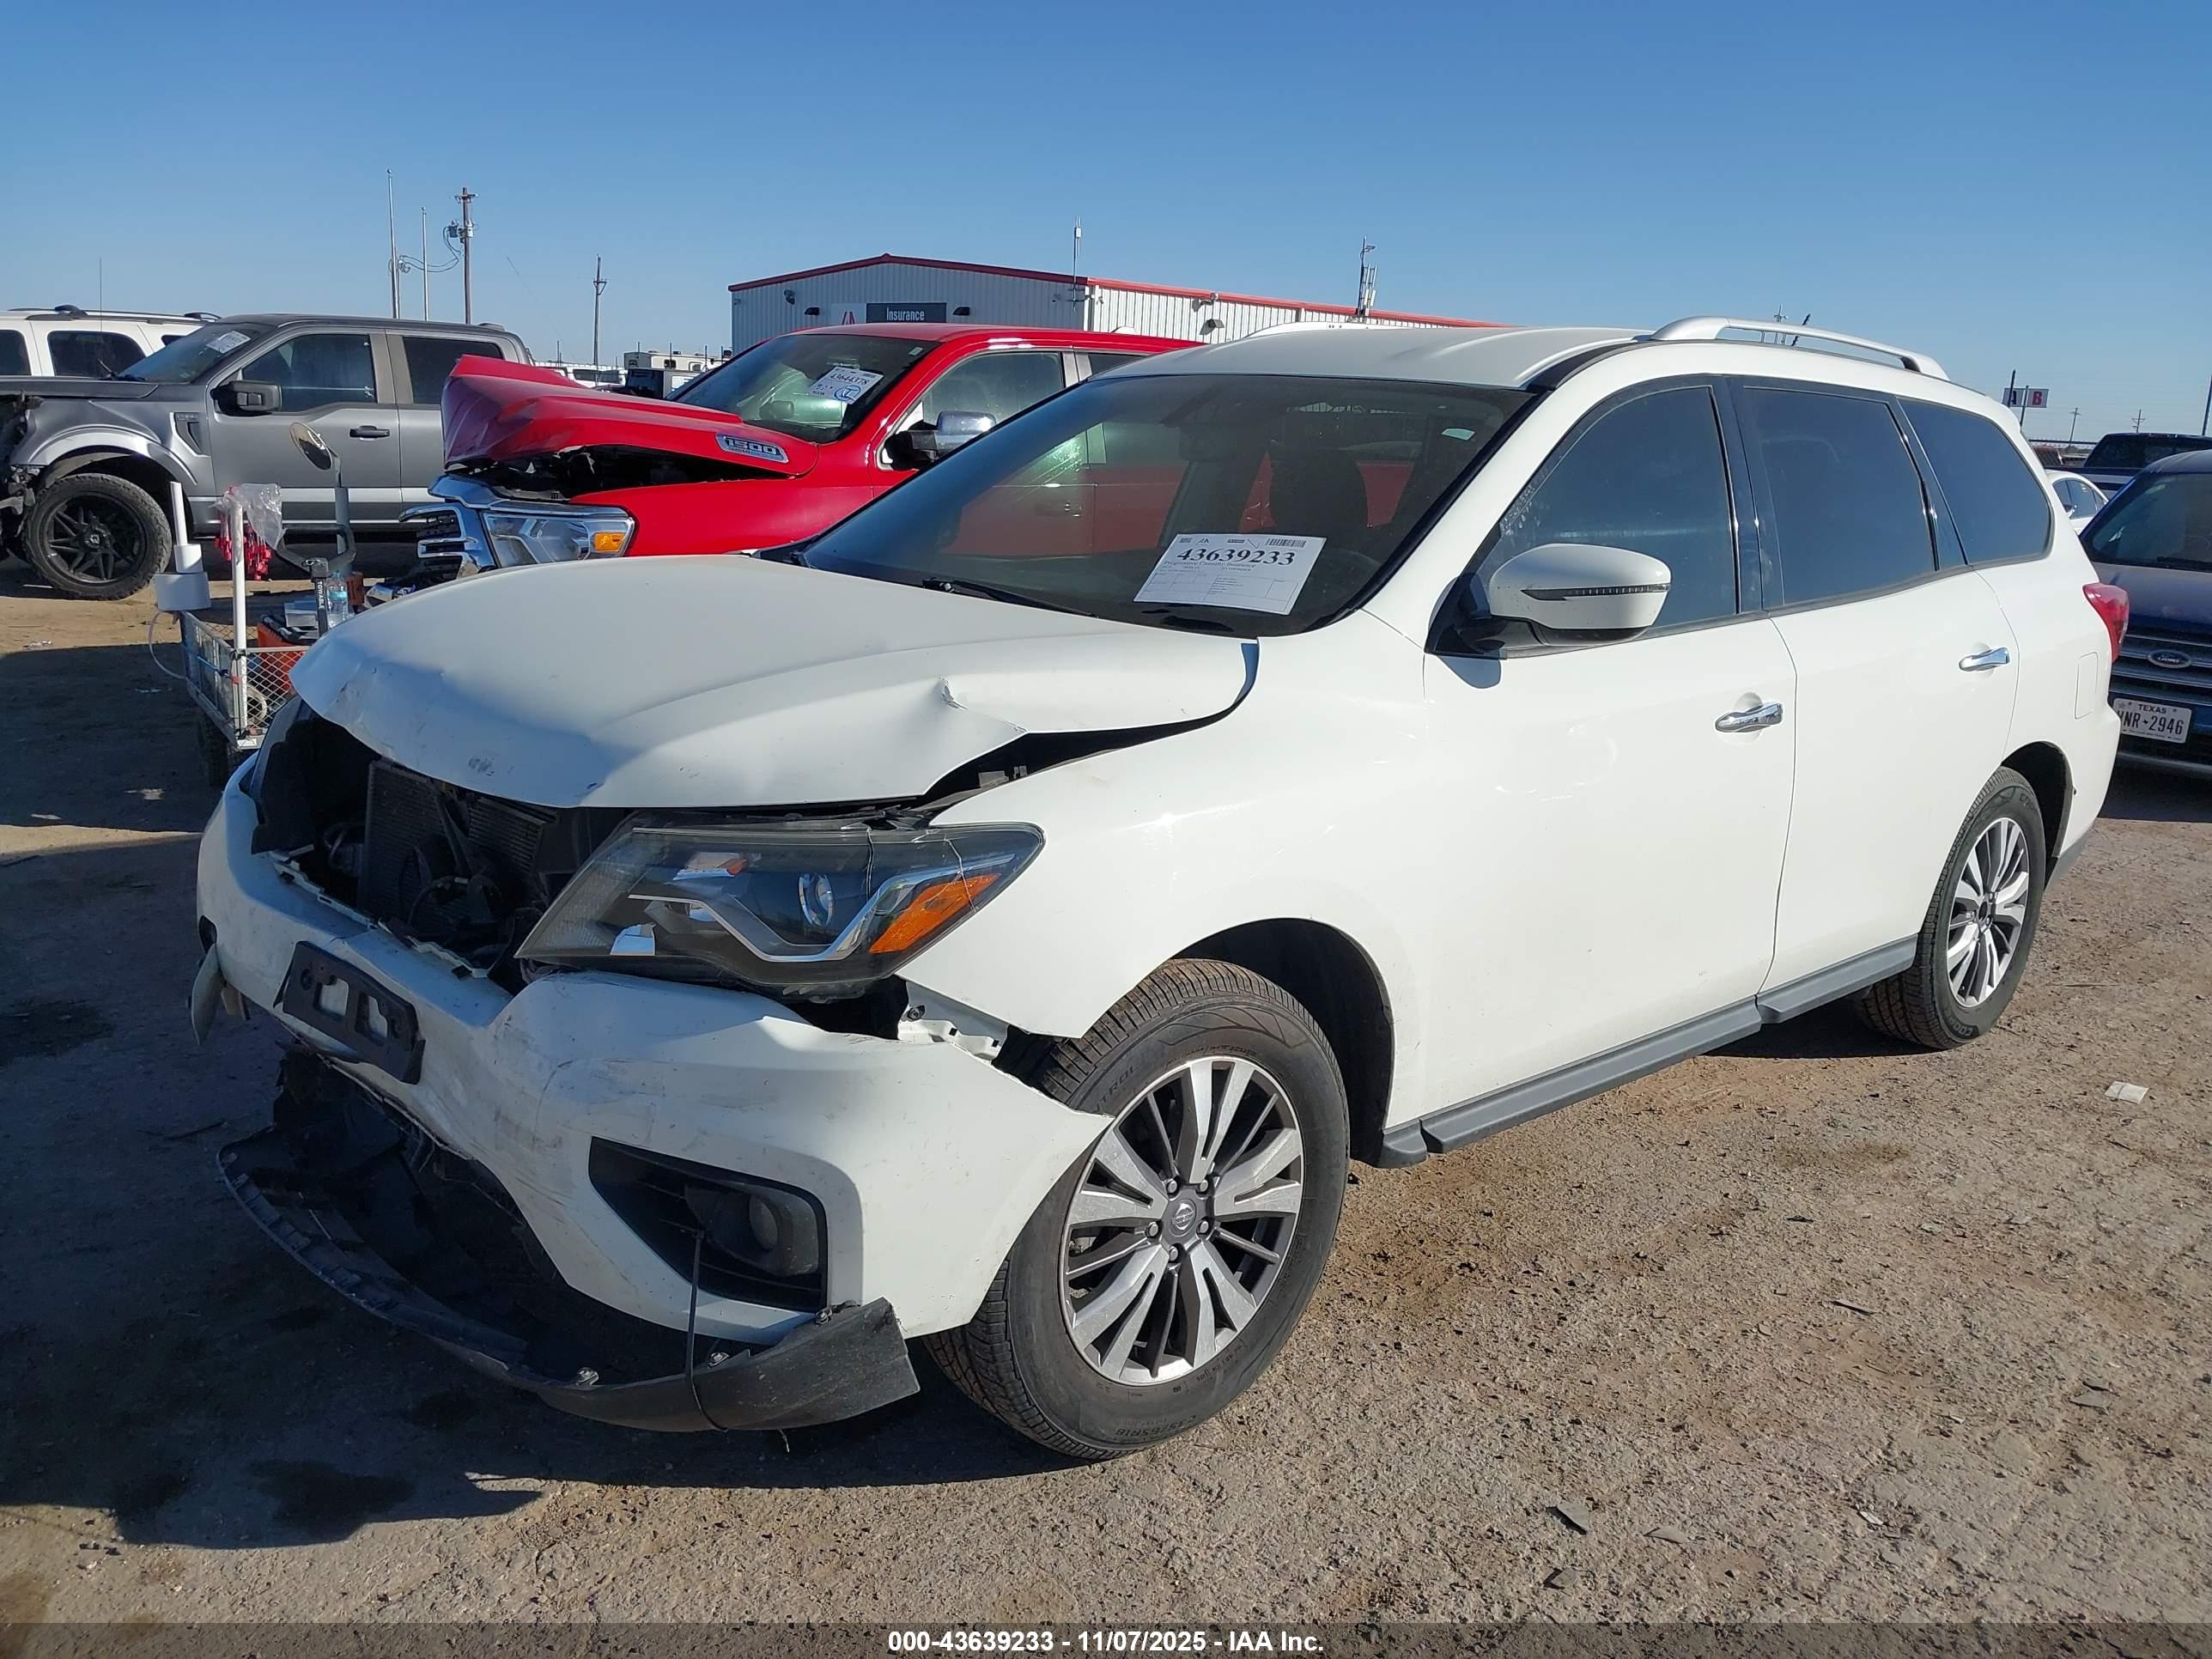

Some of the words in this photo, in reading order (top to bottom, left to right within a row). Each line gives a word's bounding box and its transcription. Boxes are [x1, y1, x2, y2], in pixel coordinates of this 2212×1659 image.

[886, 307, 925, 321] Insurance
[2033, 391, 2043, 405] B
[727, 438, 777, 455] 1500
[1176, 548, 1296, 566] 43639233
[2137, 703, 2167, 714] TEXAS
[2148, 715, 2185, 735] 2946
